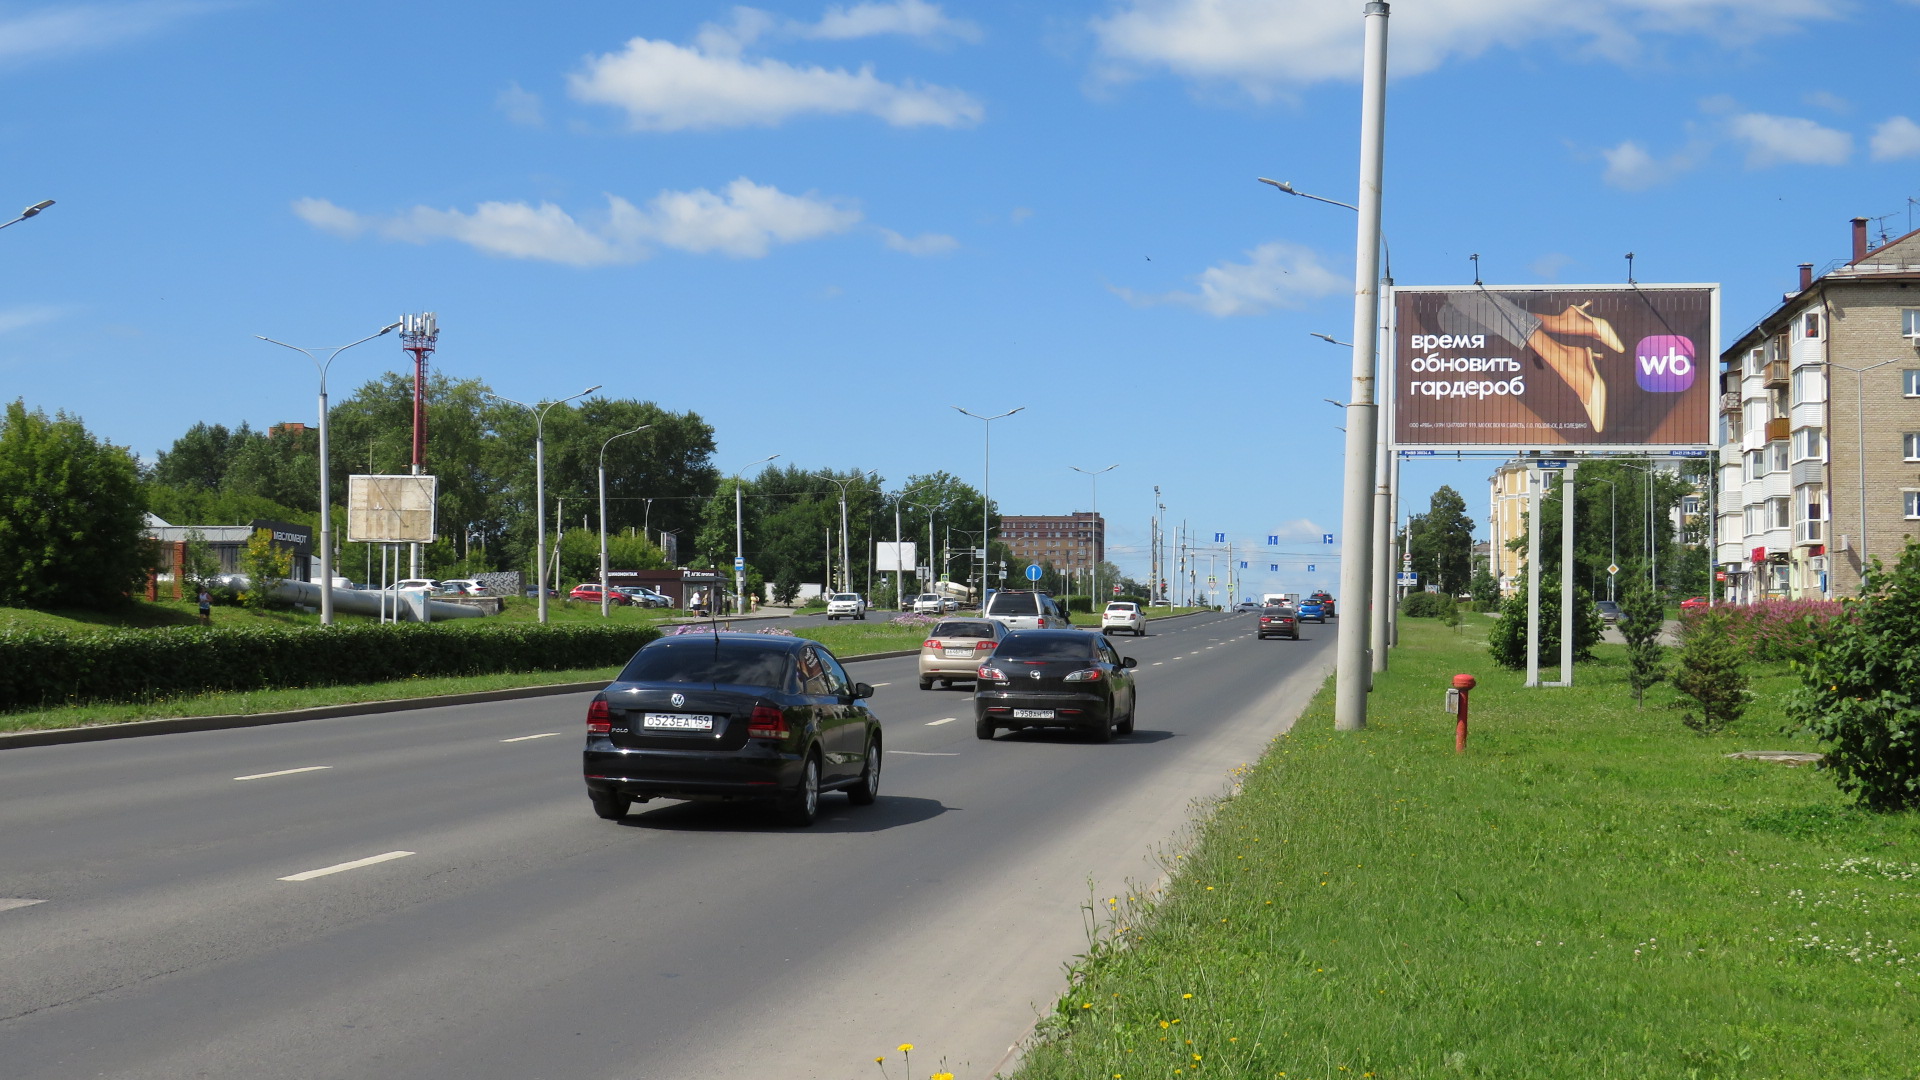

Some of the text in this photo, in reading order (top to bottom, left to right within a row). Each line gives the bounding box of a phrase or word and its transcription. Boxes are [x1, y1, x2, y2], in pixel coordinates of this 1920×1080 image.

[1411, 334, 1485, 354] время
[1411, 352, 1521, 373] обновить
[1638, 346, 1691, 376] wb
[1410, 375, 1525, 400] гардероб
[692, 714, 711, 725] 159
